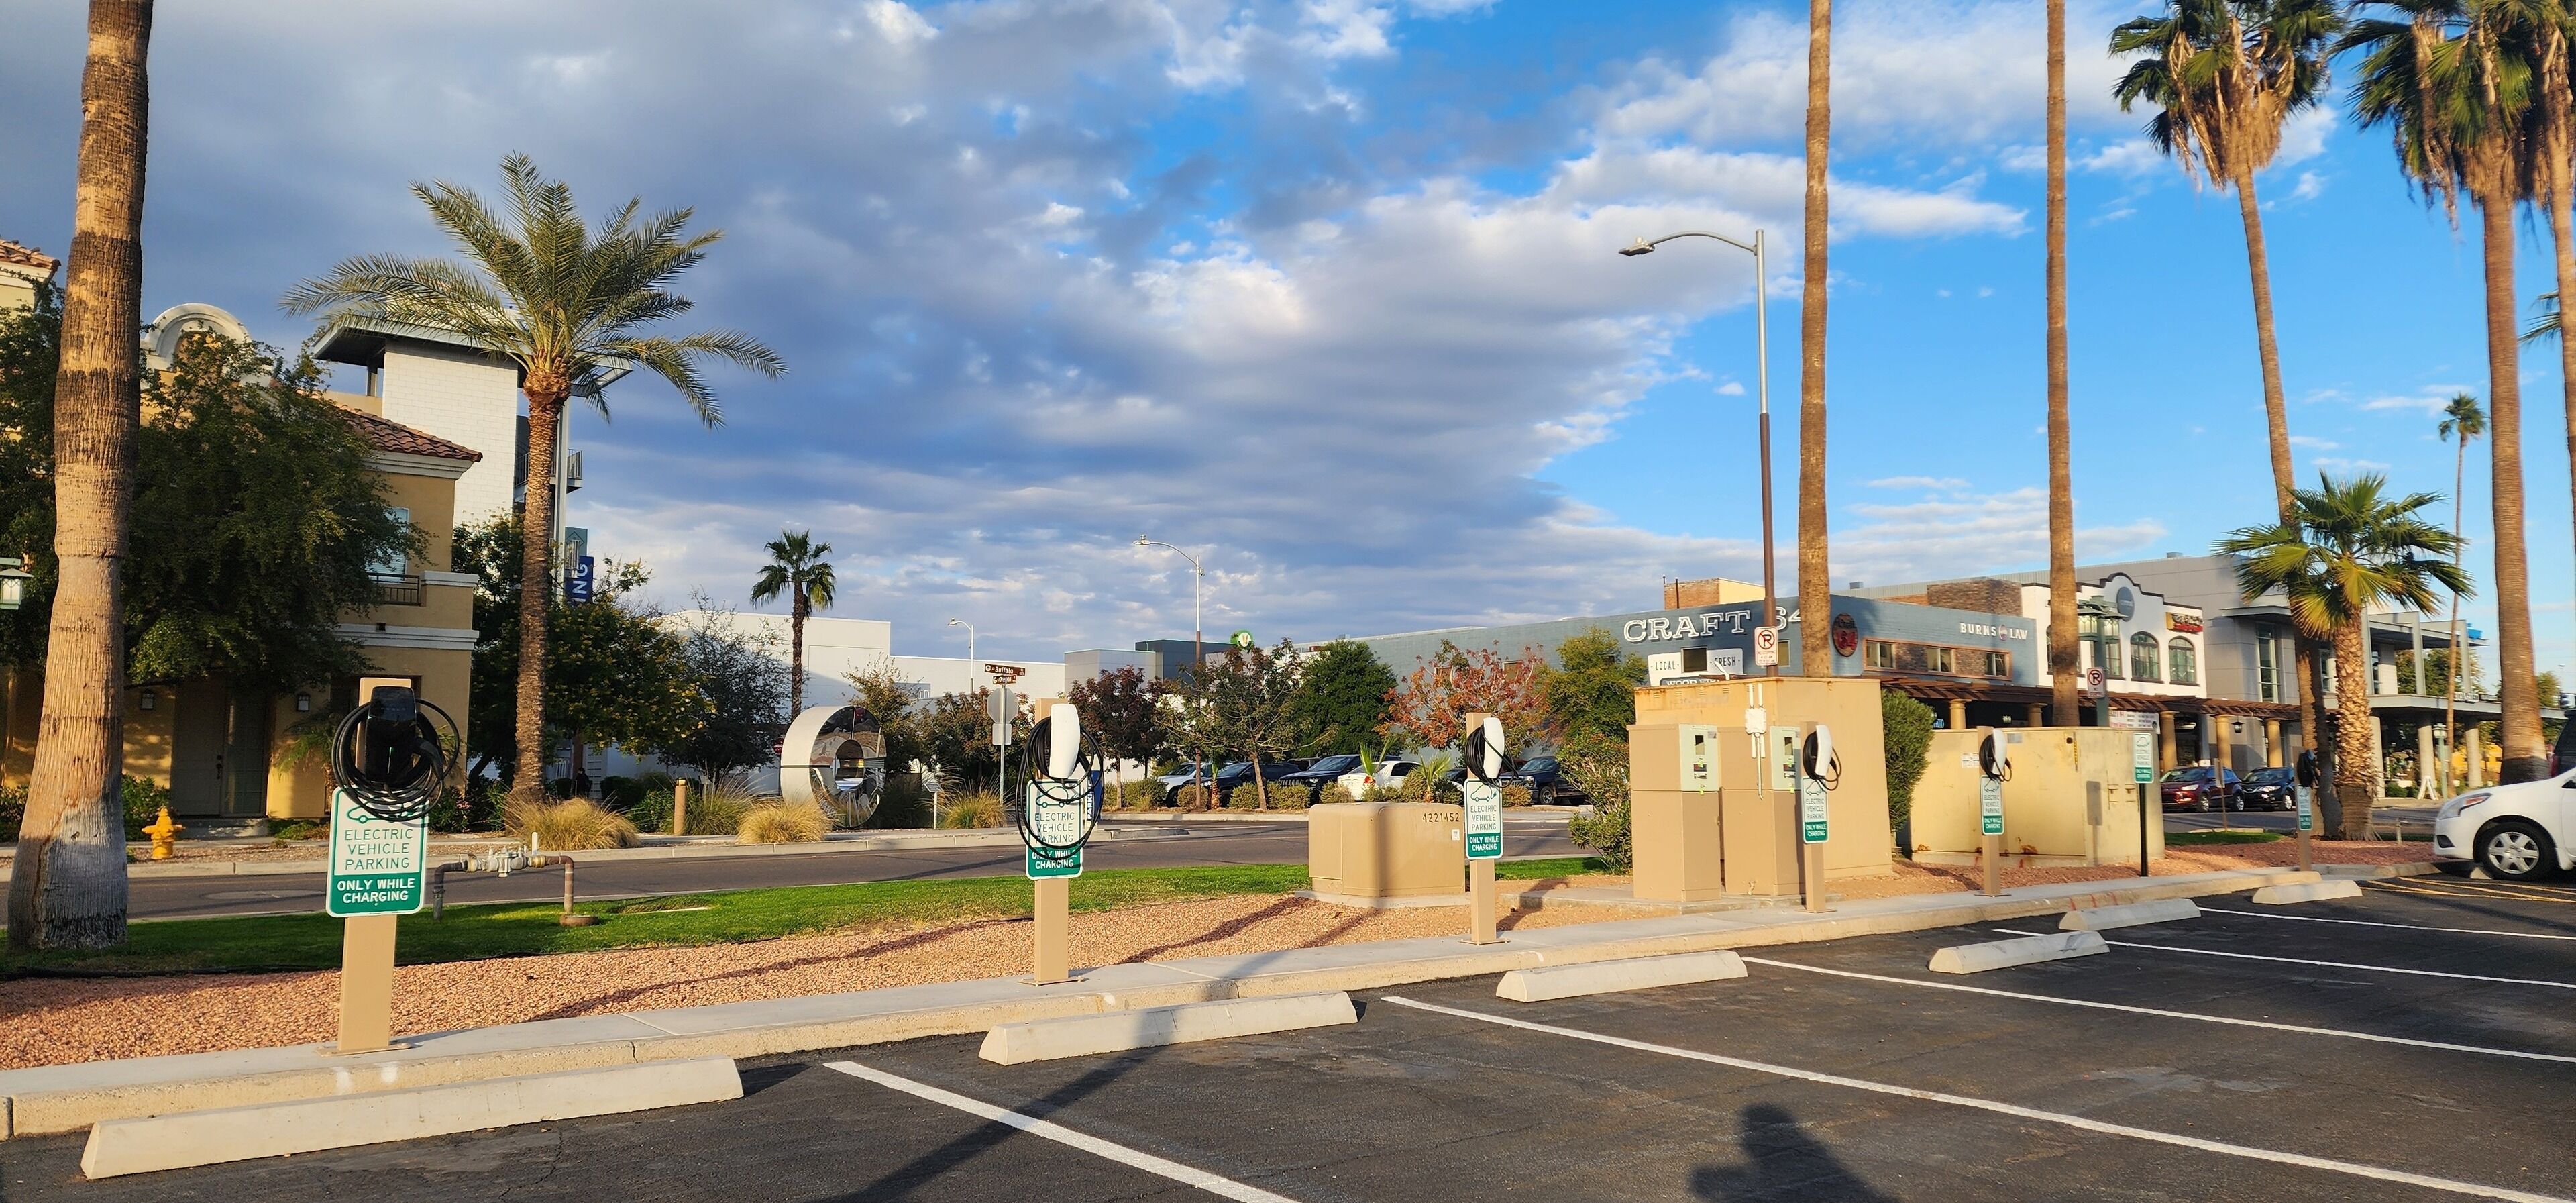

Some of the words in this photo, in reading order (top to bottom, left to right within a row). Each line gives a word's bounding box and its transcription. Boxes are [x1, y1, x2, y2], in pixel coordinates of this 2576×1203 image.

[1623, 610, 1751, 643] CRAFT
[1960, 622, 1997, 637] BURNS
[2010, 628, 2028, 640] LAW
[1656, 661, 1676, 671] LOCAL
[1714, 656, 1737, 667] FRESH
[995, 666, 1014, 674] Buffalo
[1034, 812, 1075, 821] ELECTRIC
[1422, 812, 1460, 823] 4221452
[1472, 814, 1496, 822] VEHICLE
[1036, 823, 1073, 832] VEHICLE
[1471, 823, 1497, 831] PARKING
[344, 828, 414, 841] ELECTRIC
[1036, 834, 1073, 844] PARKING
[347, 843, 410, 855] VEHICLE
[1472, 843, 1497, 851] CHARGING
[345, 857, 410, 870] PARKING
[1035, 859, 1074, 870] CHARGING
[337, 879, 374, 891] ONLY
[377, 878, 415, 890] WHILE
[343, 890, 409, 904] CHARGING
